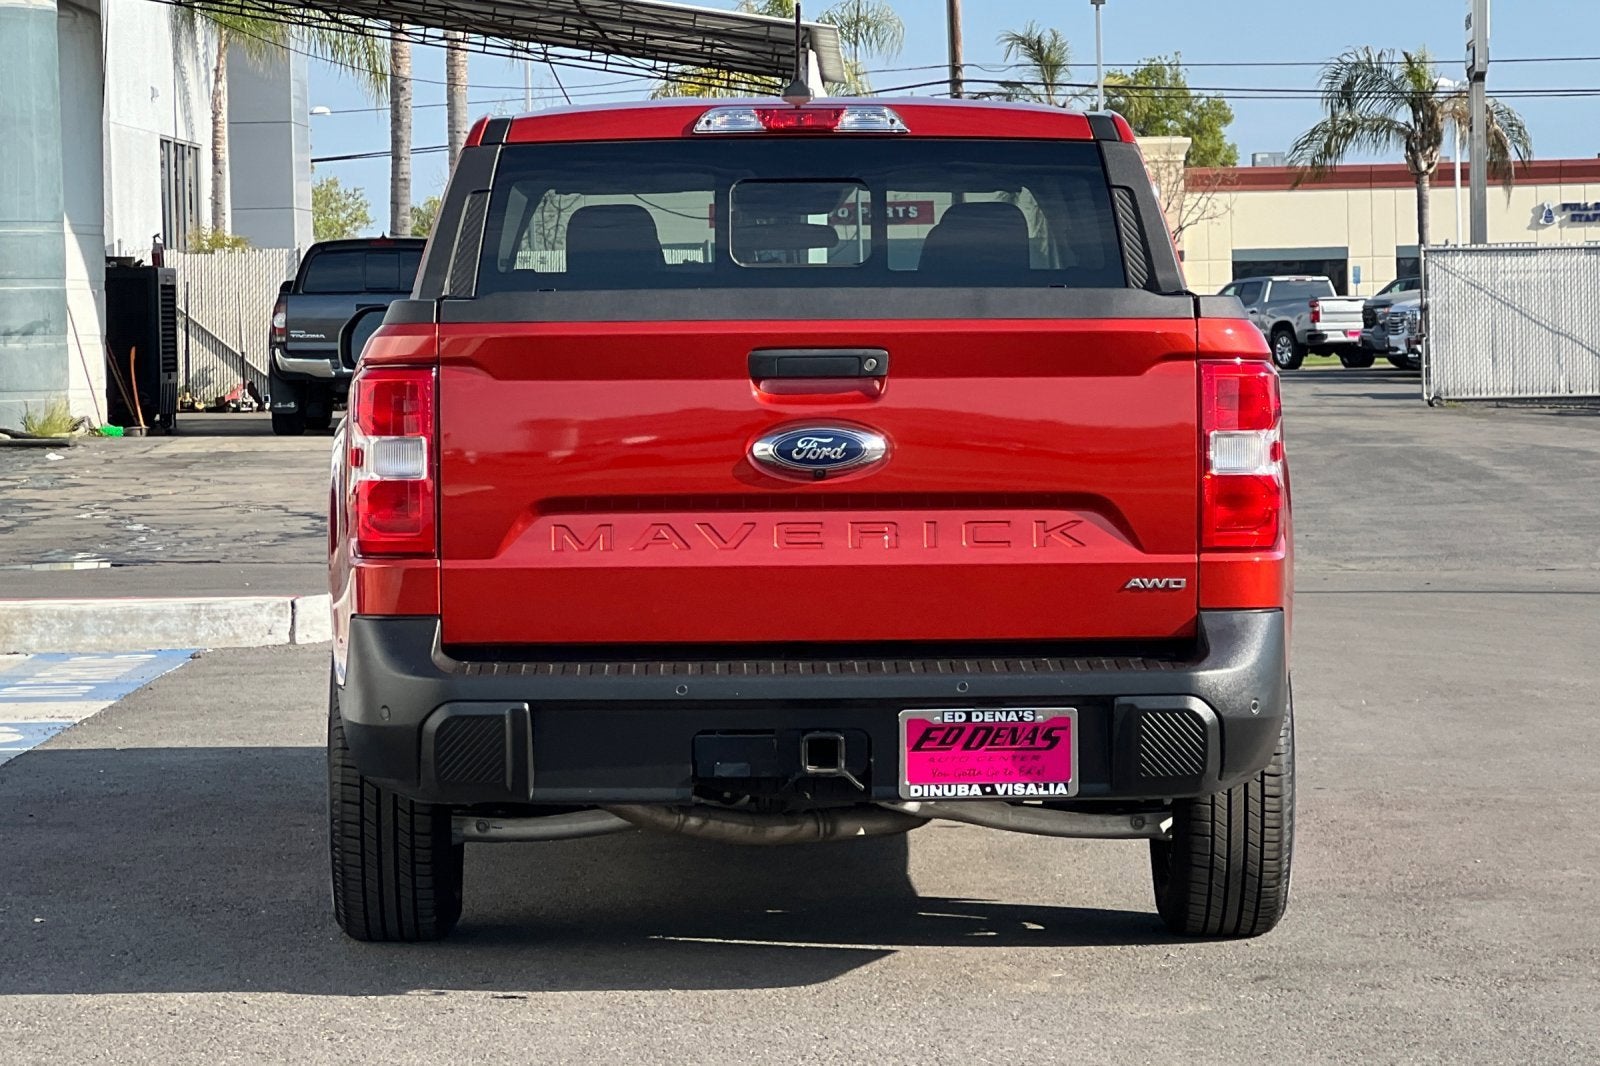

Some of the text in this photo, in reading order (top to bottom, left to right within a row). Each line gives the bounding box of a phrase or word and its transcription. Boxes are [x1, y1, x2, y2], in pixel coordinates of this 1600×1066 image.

[859, 206, 918, 218] PRTS
[791, 436, 847, 460] Ford
[551, 520, 1087, 552] MAVERICK
[1124, 578, 1187, 589] AWD
[943, 710, 1035, 723] ED DENA'S
[909, 725, 1068, 752] ED DENA'S
[909, 782, 1068, 797] DINUBA VISALIA
